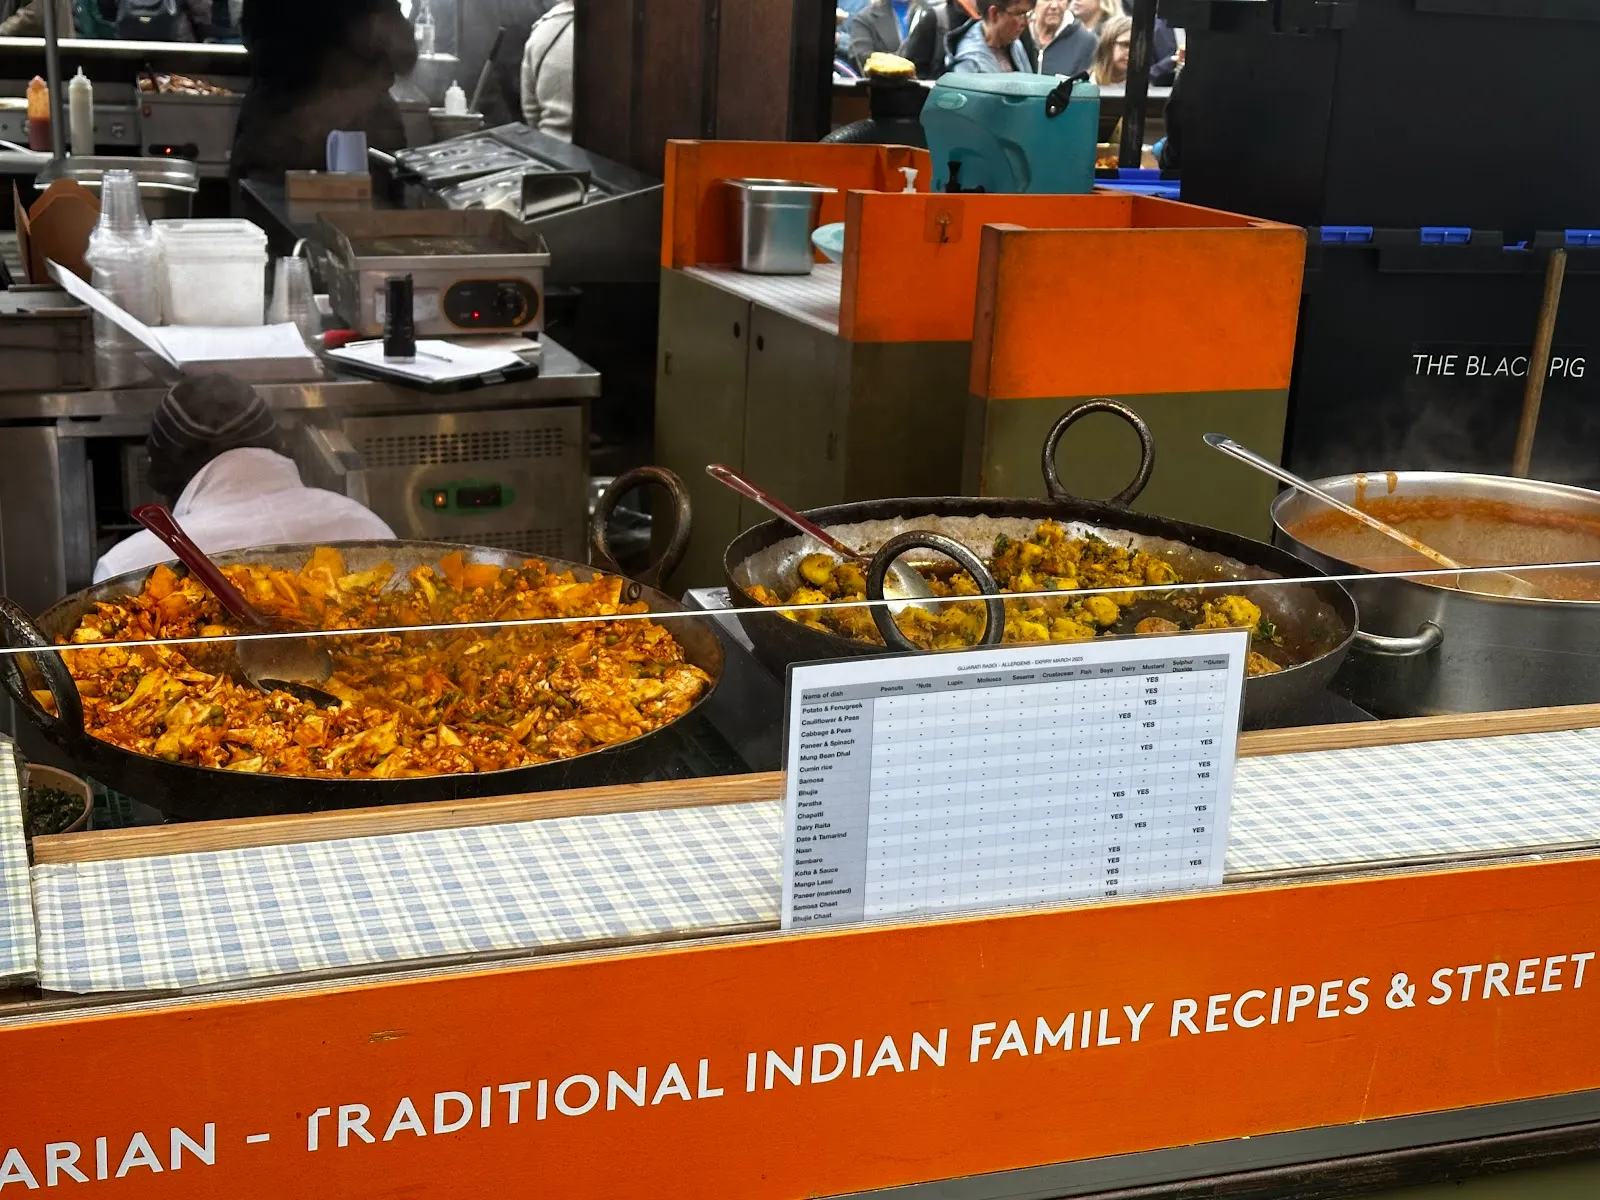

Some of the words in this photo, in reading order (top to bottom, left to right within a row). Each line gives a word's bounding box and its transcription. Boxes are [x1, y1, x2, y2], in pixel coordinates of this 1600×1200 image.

[1412, 354, 1458, 376] THE
[1550, 358, 1586, 378] PIG
[830, 703, 863, 711] Fenugreek
[830, 738, 855, 747] Spinach
[819, 832, 847, 840] Tamarind
[817, 888, 852, 898] (marinated)
[0, 1122, 216, 1192] ARIAN
[308, 1058, 724, 1152] TRADITIONAL
[746, 1028, 948, 1092] INDIAN
[970, 1002, 1154, 1063] FAMILY
[1170, 976, 1370, 1036] RECIPES
[1384, 972, 1416, 1010] &
[1427, 952, 1596, 1006] STREET
